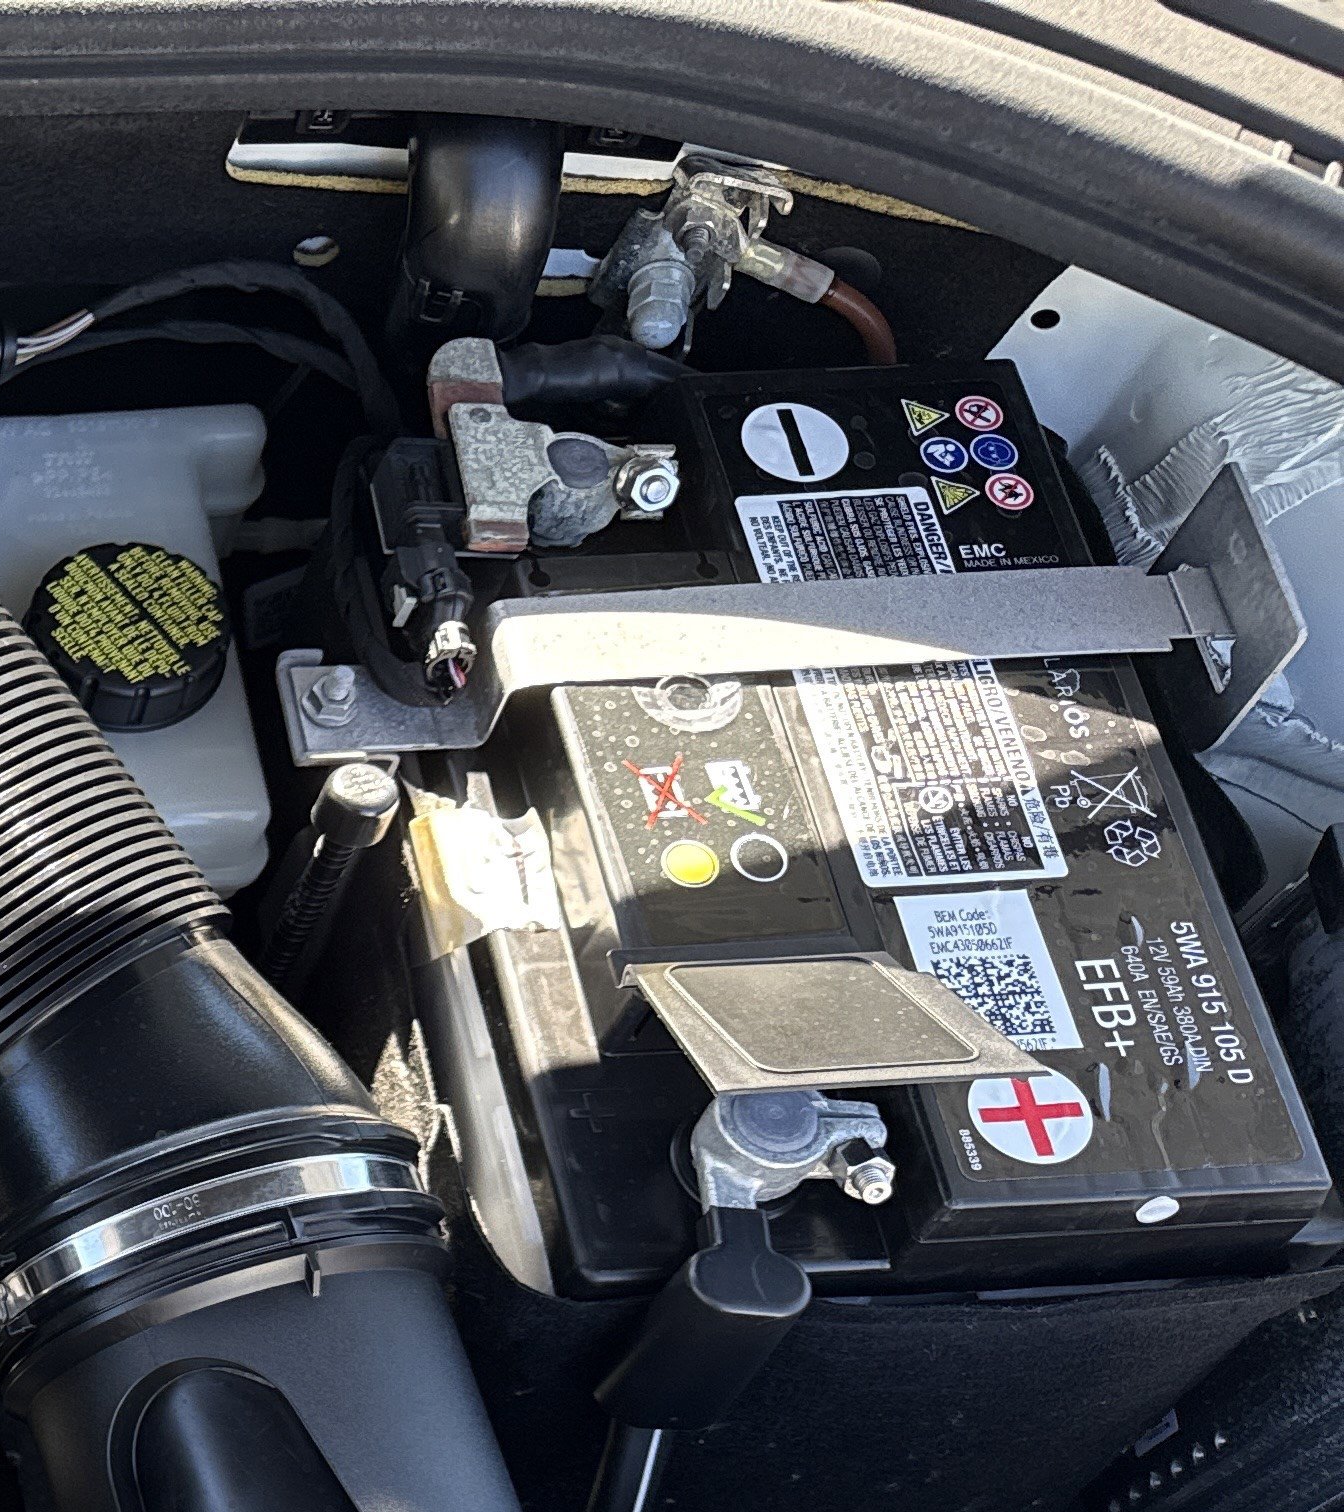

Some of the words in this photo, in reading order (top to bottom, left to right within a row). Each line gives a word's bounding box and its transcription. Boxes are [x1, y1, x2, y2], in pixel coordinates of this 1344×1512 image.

[862, 497, 875, 509] LES
[748, 516, 760, 526] NO
[759, 516, 772, 529] DES
[770, 515, 784, 532] KEEP
[873, 497, 885, 506] SE
[890, 543, 902, 556] LES
[777, 534, 789, 547] OUT
[912, 501, 952, 573] DANGER/
[782, 549, 793, 558] OF
[911, 542, 932, 573] EXPLOSIV
[958, 543, 1006, 558] EMC
[963, 559, 996, 567] MADE
[1000, 557, 1011, 565] IN
[1014, 555, 1058, 565] MEXICO
[786, 560, 798, 572] THE
[1043, 657, 1089, 739] LARIOS
[971, 659, 1031, 781] LIGRO/VENENO
[978, 787, 998, 816] FLAMES
[1005, 794, 1018, 806] NO
[1049, 783, 1073, 809] Pb
[920, 818, 934, 834] LES
[868, 835, 881, 849] LOS
[881, 836, 891, 845] LA
[914, 836, 926, 846] DE
[982, 831, 1005, 868] CIGARROS
[1020, 835, 1033, 847] NO
[919, 848, 936, 872] FUMER
[926, 835, 948, 871] FLAMMES
[959, 856, 973, 870] LES
[948, 861, 960, 871] ET
[932, 909, 958, 923] BEM
[956, 907, 991, 921] Code:
[1145, 935, 1172, 966] 12V
[1169, 917, 1208, 969] 5WA
[1156, 963, 1186, 1003] 59Ah
[1189, 970, 1227, 1017] 915
[1074, 952, 1138, 1060] EFB+
[1120, 943, 1149, 982] 640A
[1137, 987, 1183, 1067] EN/SAE/GS
[1172, 1003, 1201, 1043] 380A
[1209, 1020, 1245, 1065] 105
[1189, 1045, 1213, 1075] DIN
[1226, 1064, 1254, 1086] D
